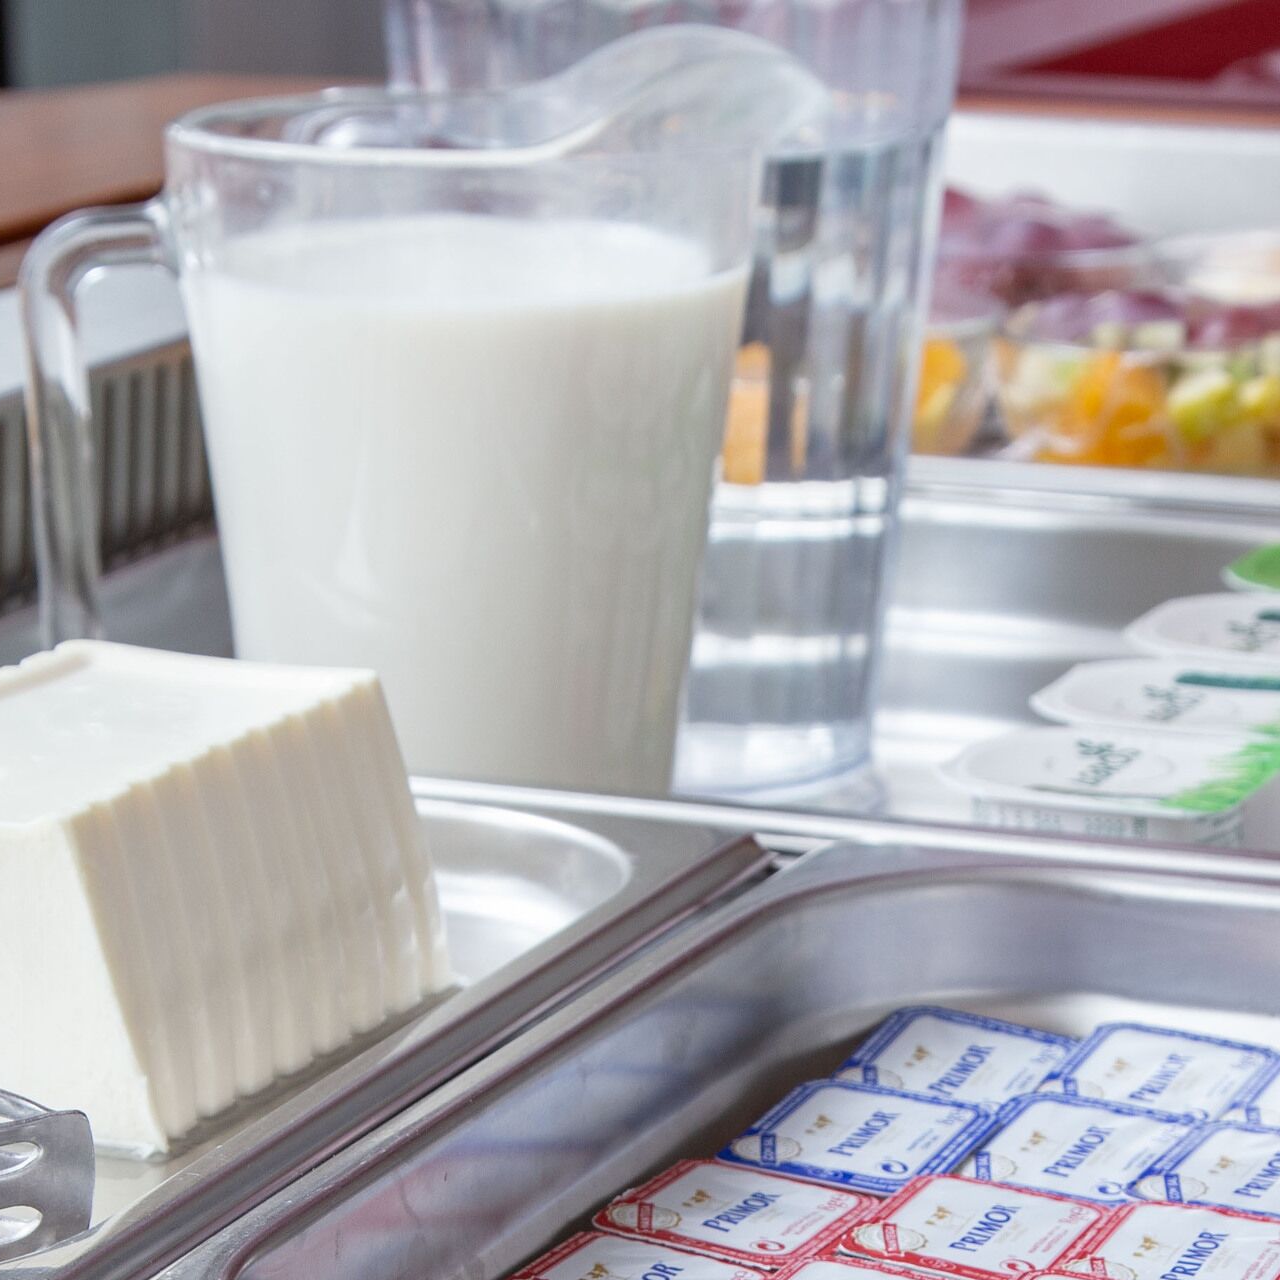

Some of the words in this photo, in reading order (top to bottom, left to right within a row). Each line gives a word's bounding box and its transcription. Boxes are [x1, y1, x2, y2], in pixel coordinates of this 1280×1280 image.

[828, 1111, 902, 1157] PRIMOR
[1043, 1126, 1114, 1177] PRIMOR
[702, 1191, 783, 1232] PRIMOR
[949, 1204, 1022, 1252] PRIMOR
